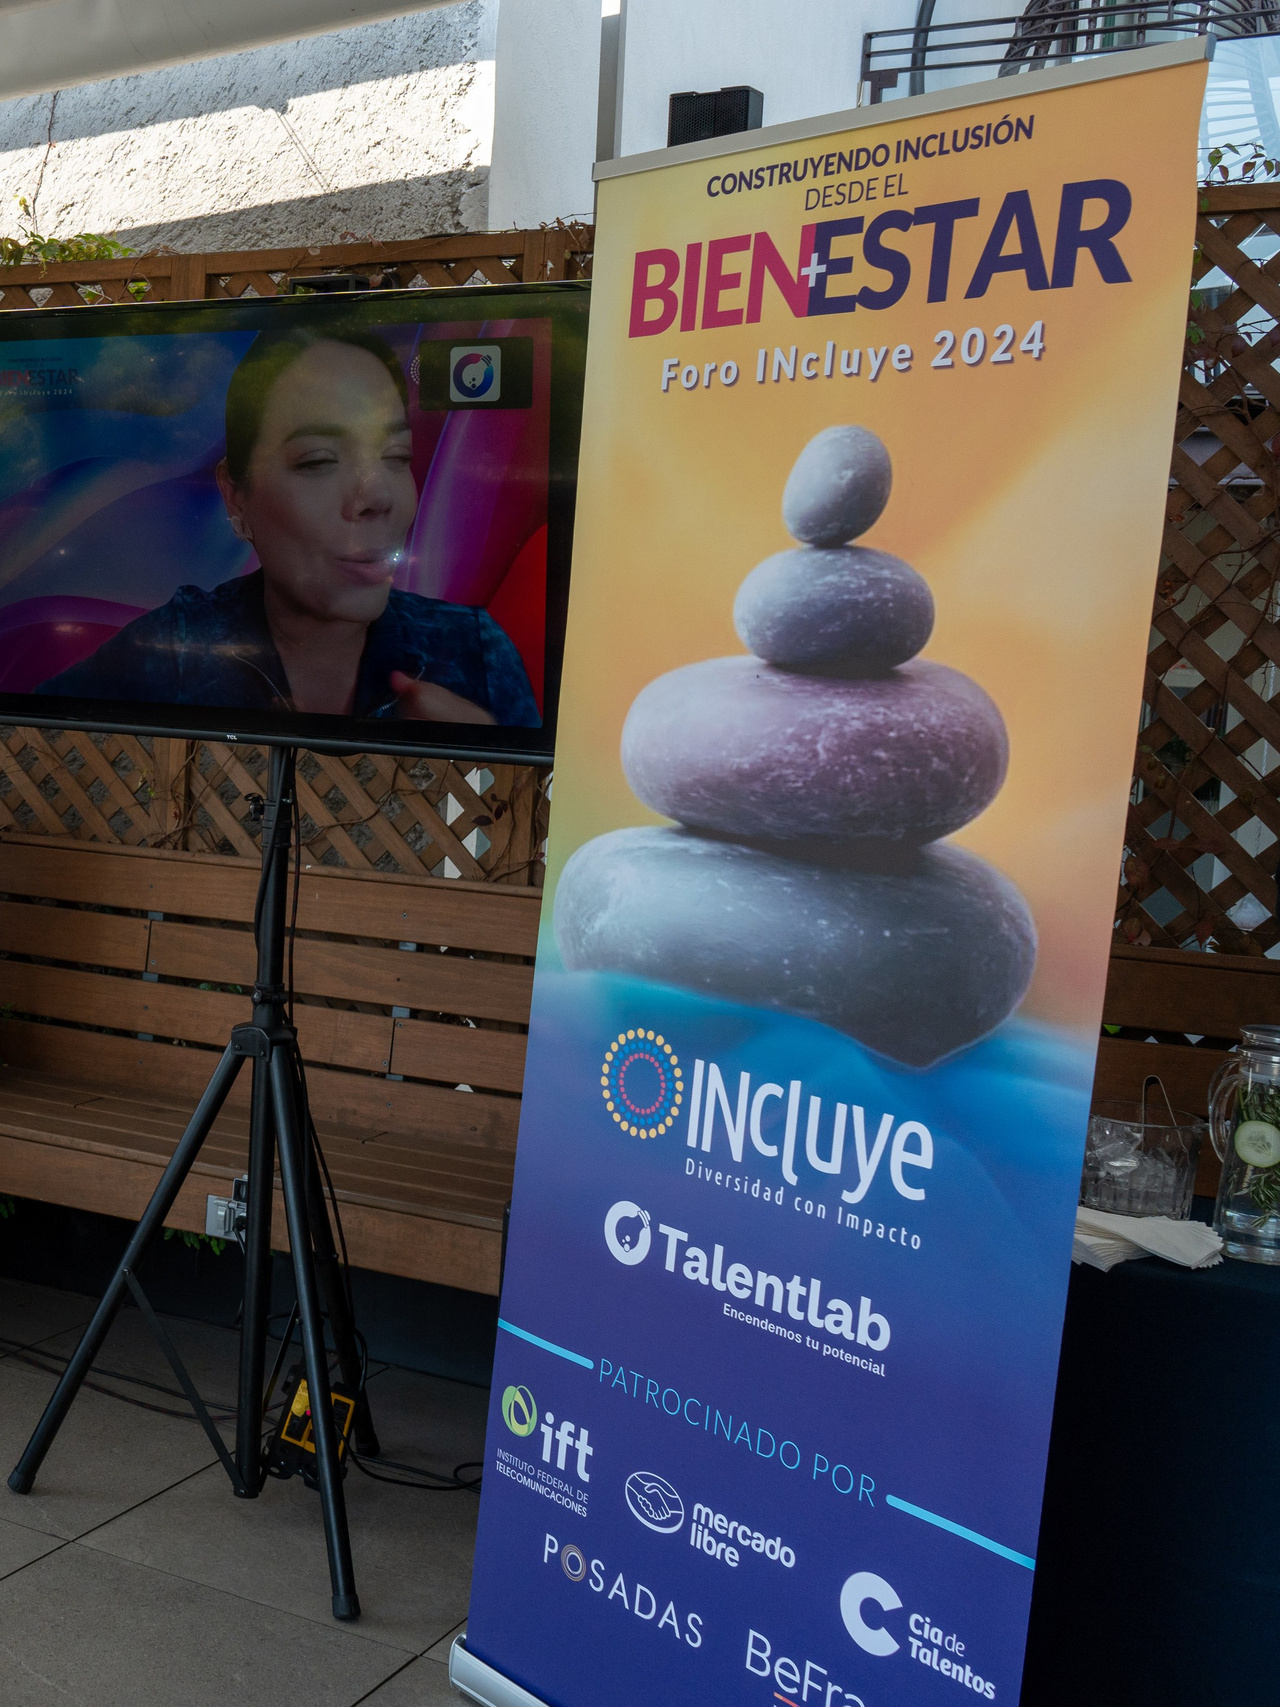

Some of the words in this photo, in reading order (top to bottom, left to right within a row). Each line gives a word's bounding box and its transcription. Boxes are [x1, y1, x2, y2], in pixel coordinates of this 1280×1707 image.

[706, 143, 891, 198] CONSTRUYENDO
[895, 114, 1035, 164] INCLUSIÓN
[804, 173, 878, 211] DESDE
[883, 172, 909, 198] EL
[661, 357, 739, 392] Foro
[755, 340, 914, 384] INcluye
[931, 320, 1046, 369] 2024
[686, 1058, 934, 1204] INcluye
[685, 1158, 785, 1206] Diversidad
[794, 1196, 827, 1220] con
[837, 1206, 921, 1250] Impacto
[658, 1223, 891, 1352] Talentlab
[723, 1303, 803, 1345] Encendemos
[805, 1334, 820, 1351] tu
[822, 1341, 886, 1378] potencial
[540, 1411, 594, 1483] ift
[599, 1358, 802, 1471] PATROCINADO
[812, 1452, 877, 1508] POR
[495, 1460, 587, 1518] TELECOMUNICACIONES
[496, 1447, 536, 1476] INSTITUTO
[536, 1469, 574, 1497] FEDERAL
[576, 1489, 589, 1504] DE
[690, 1523, 740, 1568] libre
[692, 1502, 796, 1569] mercado
[543, 1533, 704, 1649] POSADAS
[908, 1613, 943, 1646] Cia
[943, 1633, 966, 1658] de
[908, 1636, 996, 1700] Talentos
